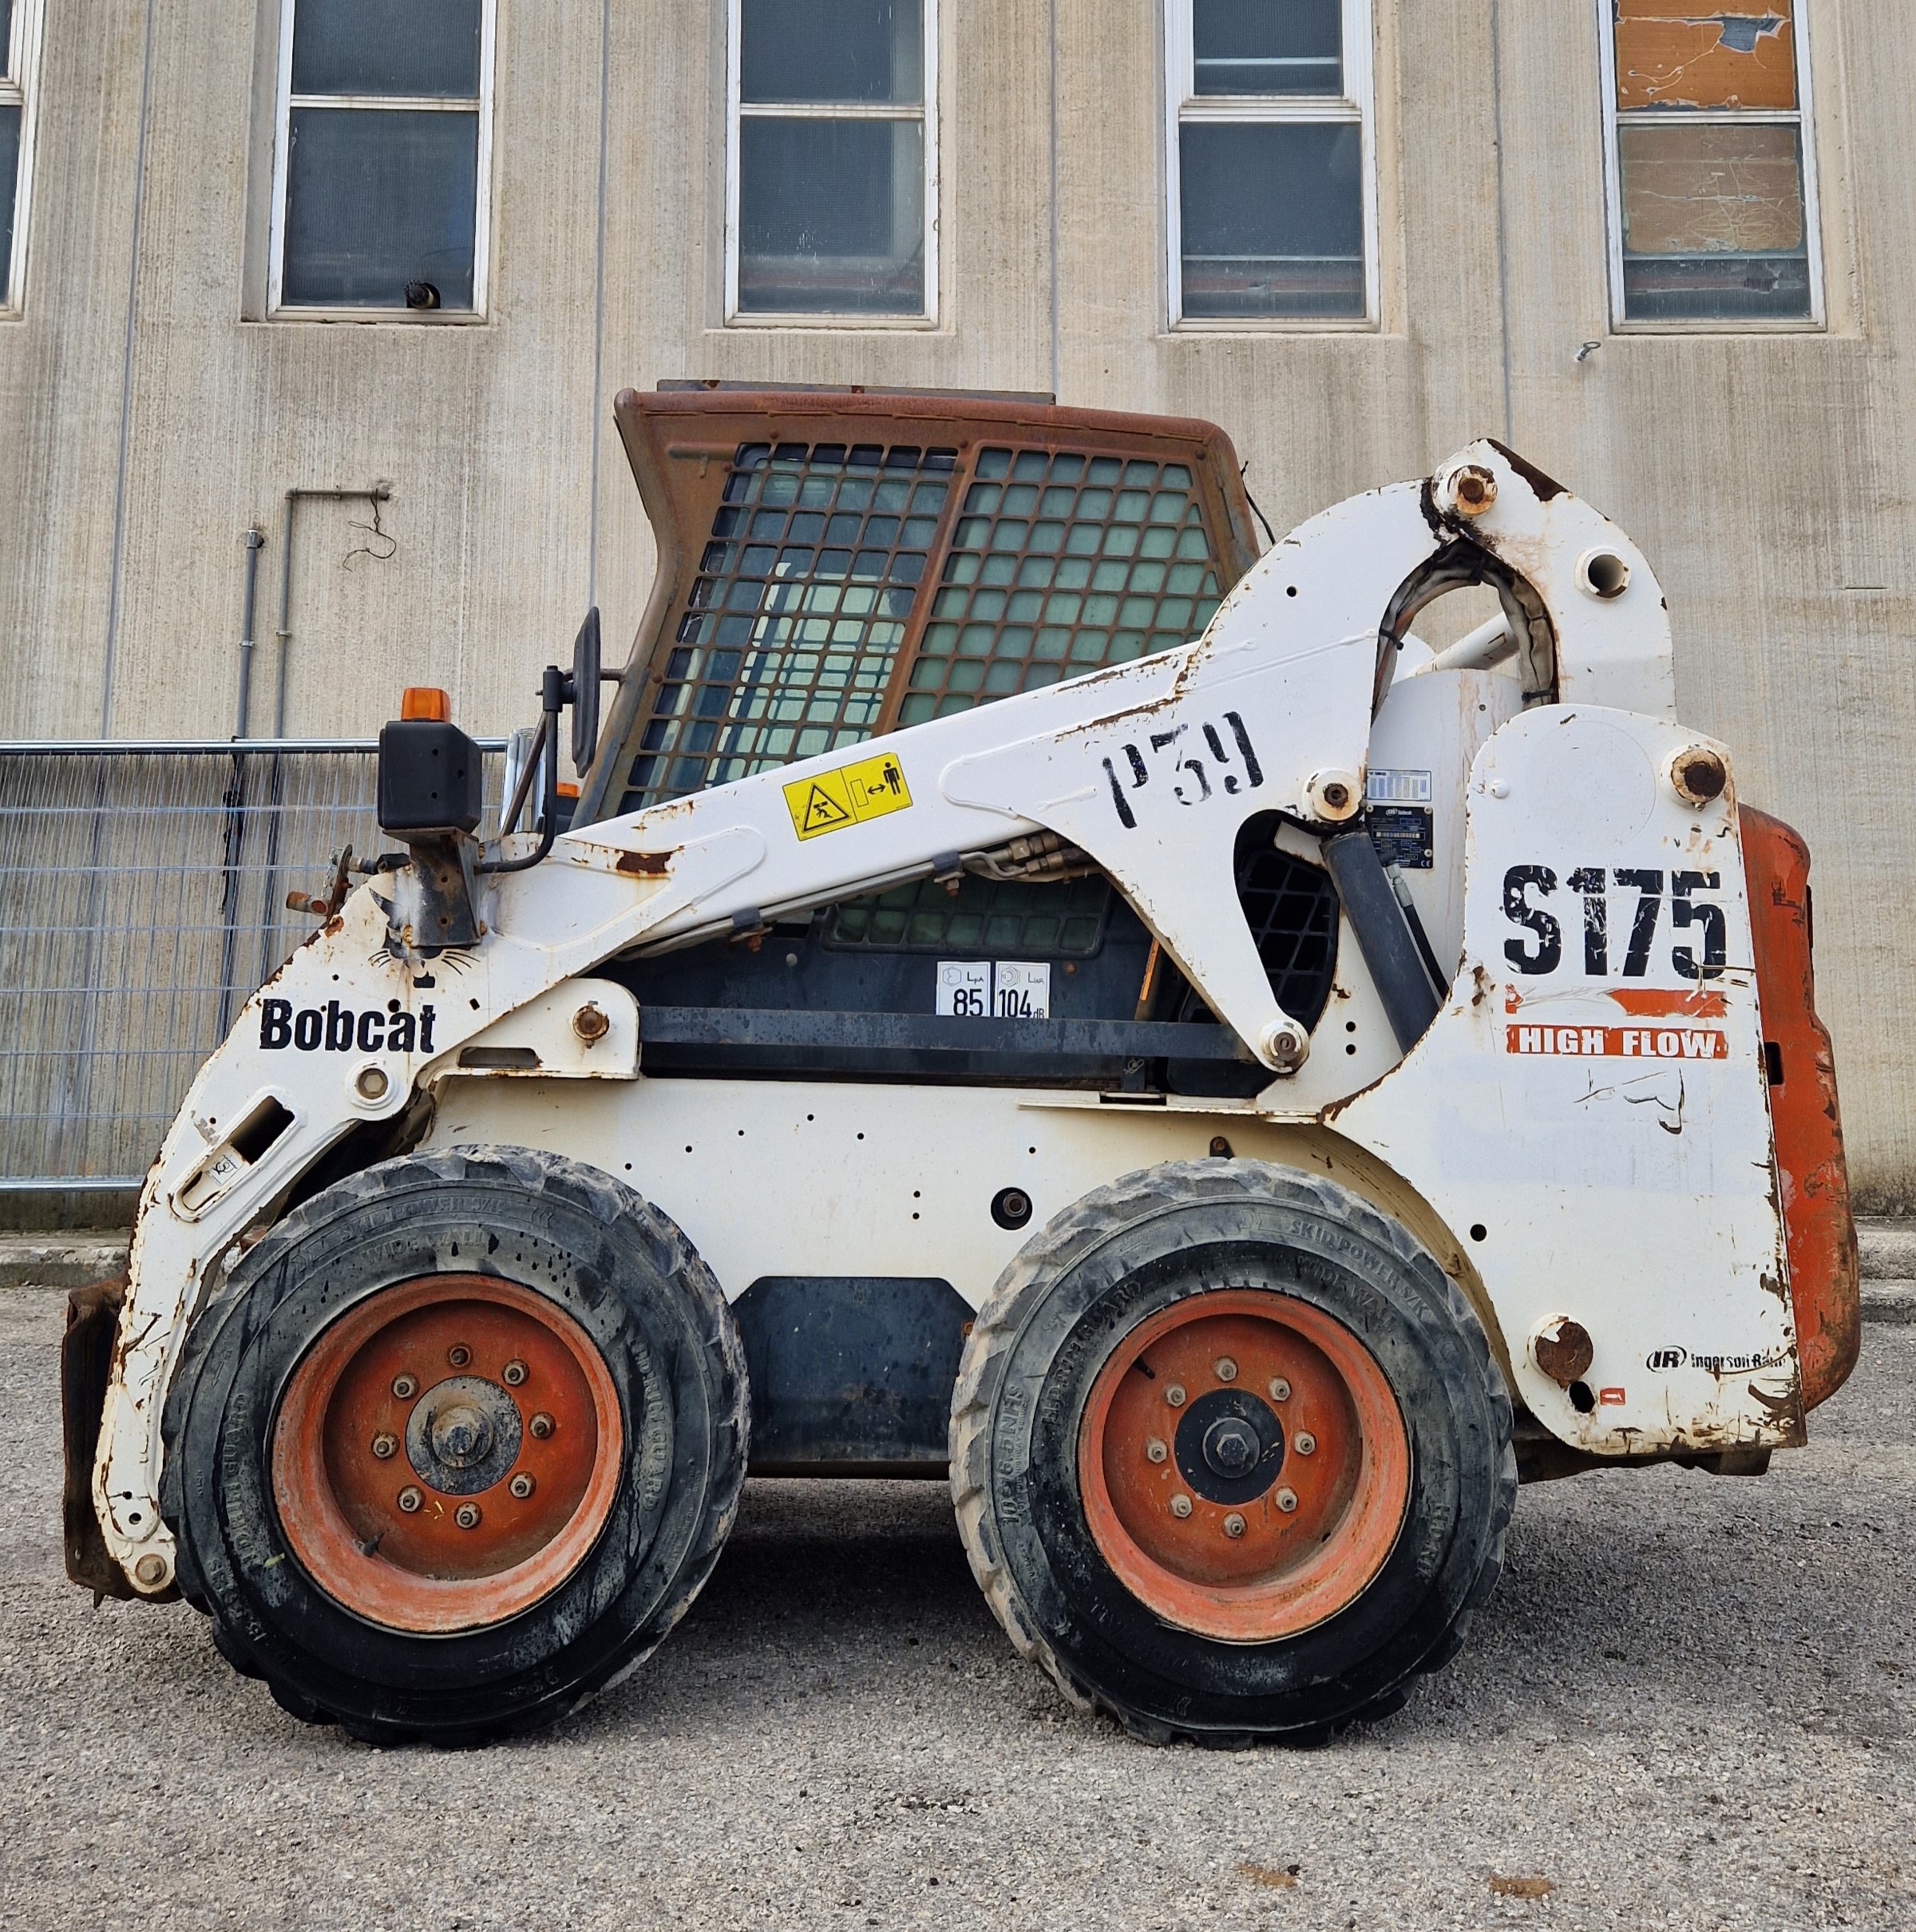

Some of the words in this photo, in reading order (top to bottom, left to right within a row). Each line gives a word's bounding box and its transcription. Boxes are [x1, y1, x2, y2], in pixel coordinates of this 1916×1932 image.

[1503, 865, 1727, 980] S175
[953, 988, 983, 1016] 85
[999, 989, 1031, 1018] 104
[259, 999, 436, 1053] Bobcat
[1518, 1027, 1605, 1055] HIGH
[1621, 1030, 1716, 1058] FLOW
[1290, 1218, 1336, 1248] SKID
[1337, 1235, 1399, 1291] POWER
